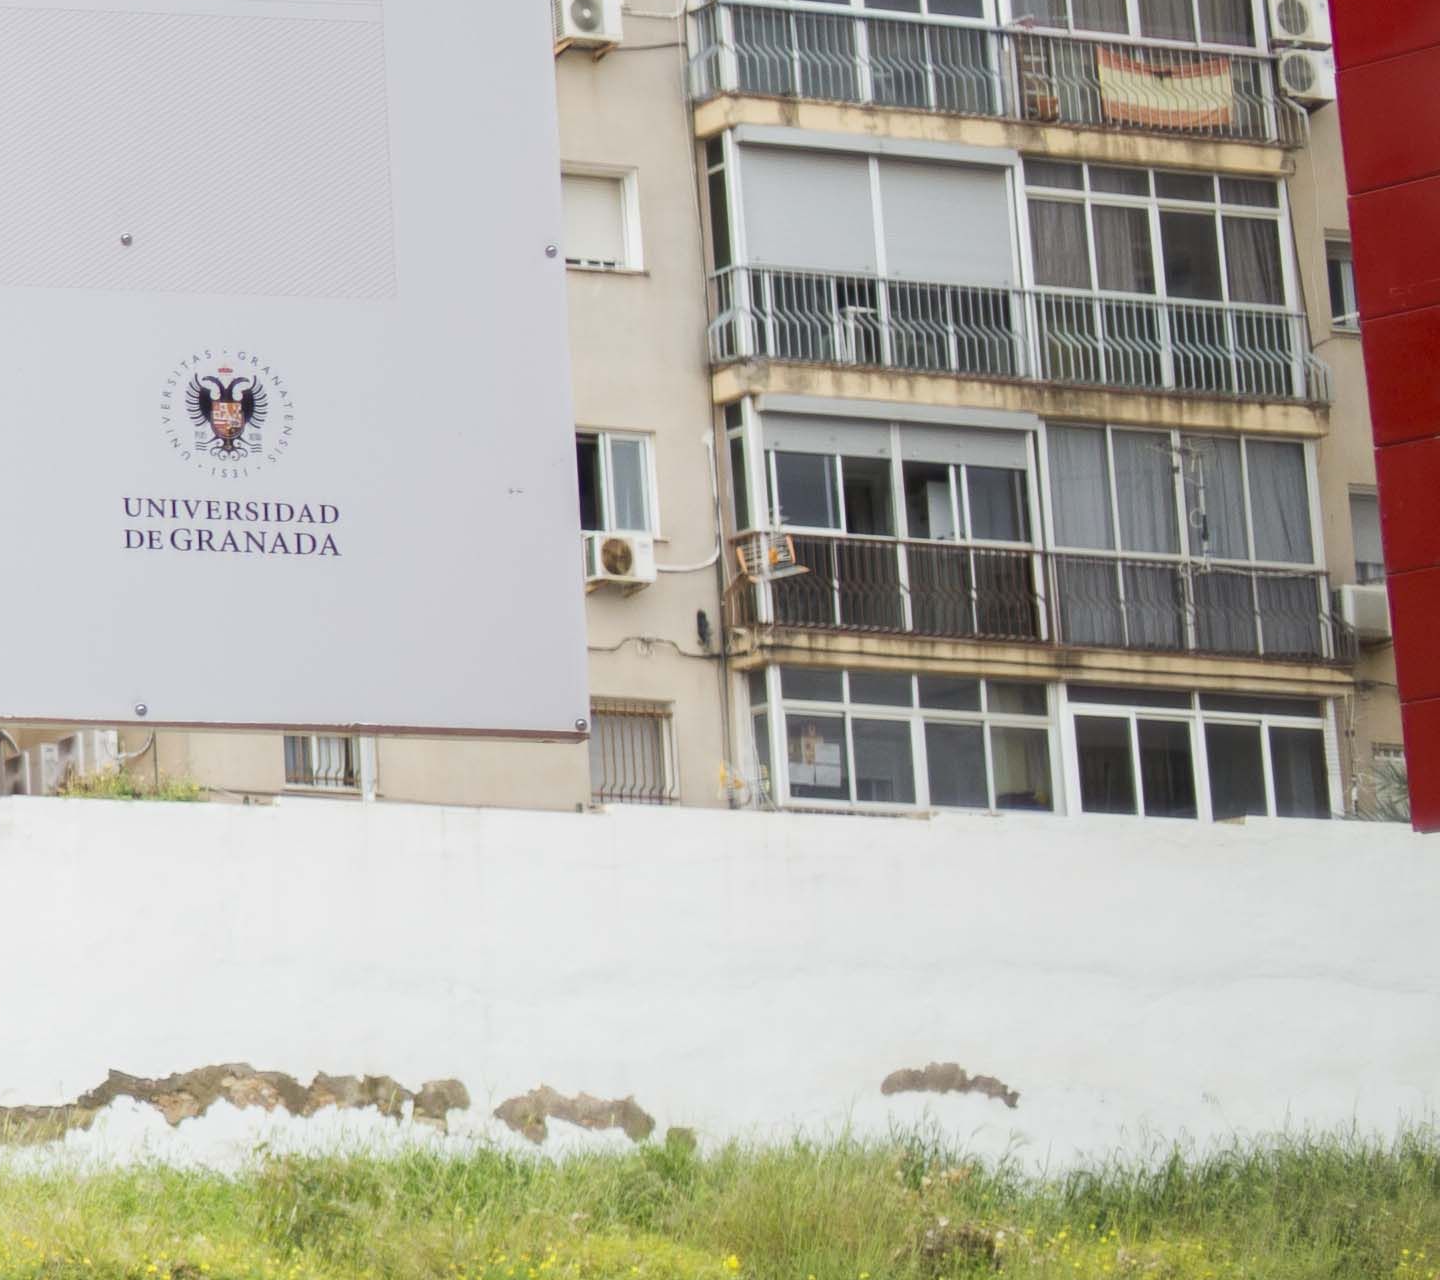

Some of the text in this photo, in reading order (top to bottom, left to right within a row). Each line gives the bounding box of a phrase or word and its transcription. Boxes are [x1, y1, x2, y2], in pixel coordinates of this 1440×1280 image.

[123, 498, 339, 524] UNIVERSIDAD
[125, 528, 342, 556] DE GRANADA
